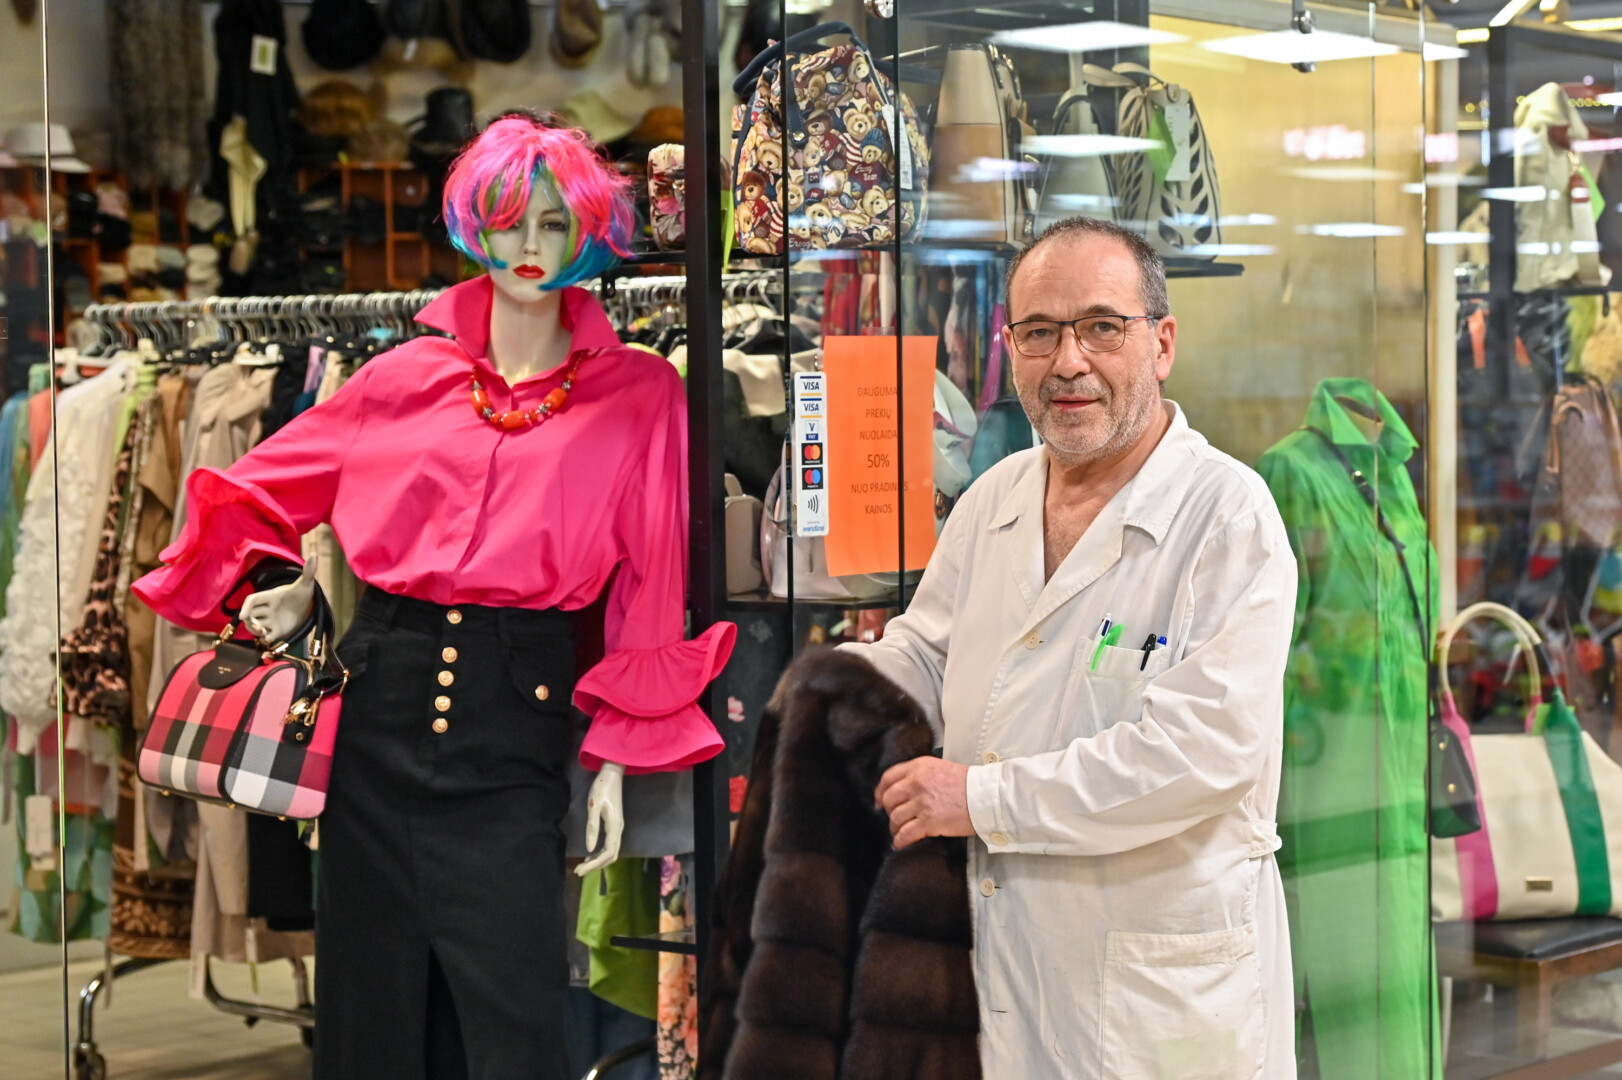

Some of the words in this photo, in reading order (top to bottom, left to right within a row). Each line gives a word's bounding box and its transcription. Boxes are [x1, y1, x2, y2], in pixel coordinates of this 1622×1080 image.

[803, 381, 820, 391] VISA
[857, 386, 899, 397] DAUGUMA
[803, 403, 820, 412] VISA
[808, 422, 815, 432] V
[867, 453, 890, 468] 50%
[851, 482, 868, 494] NUO
[870, 481, 909, 493] PRADINS
[865, 503, 892, 515] KAINOS
